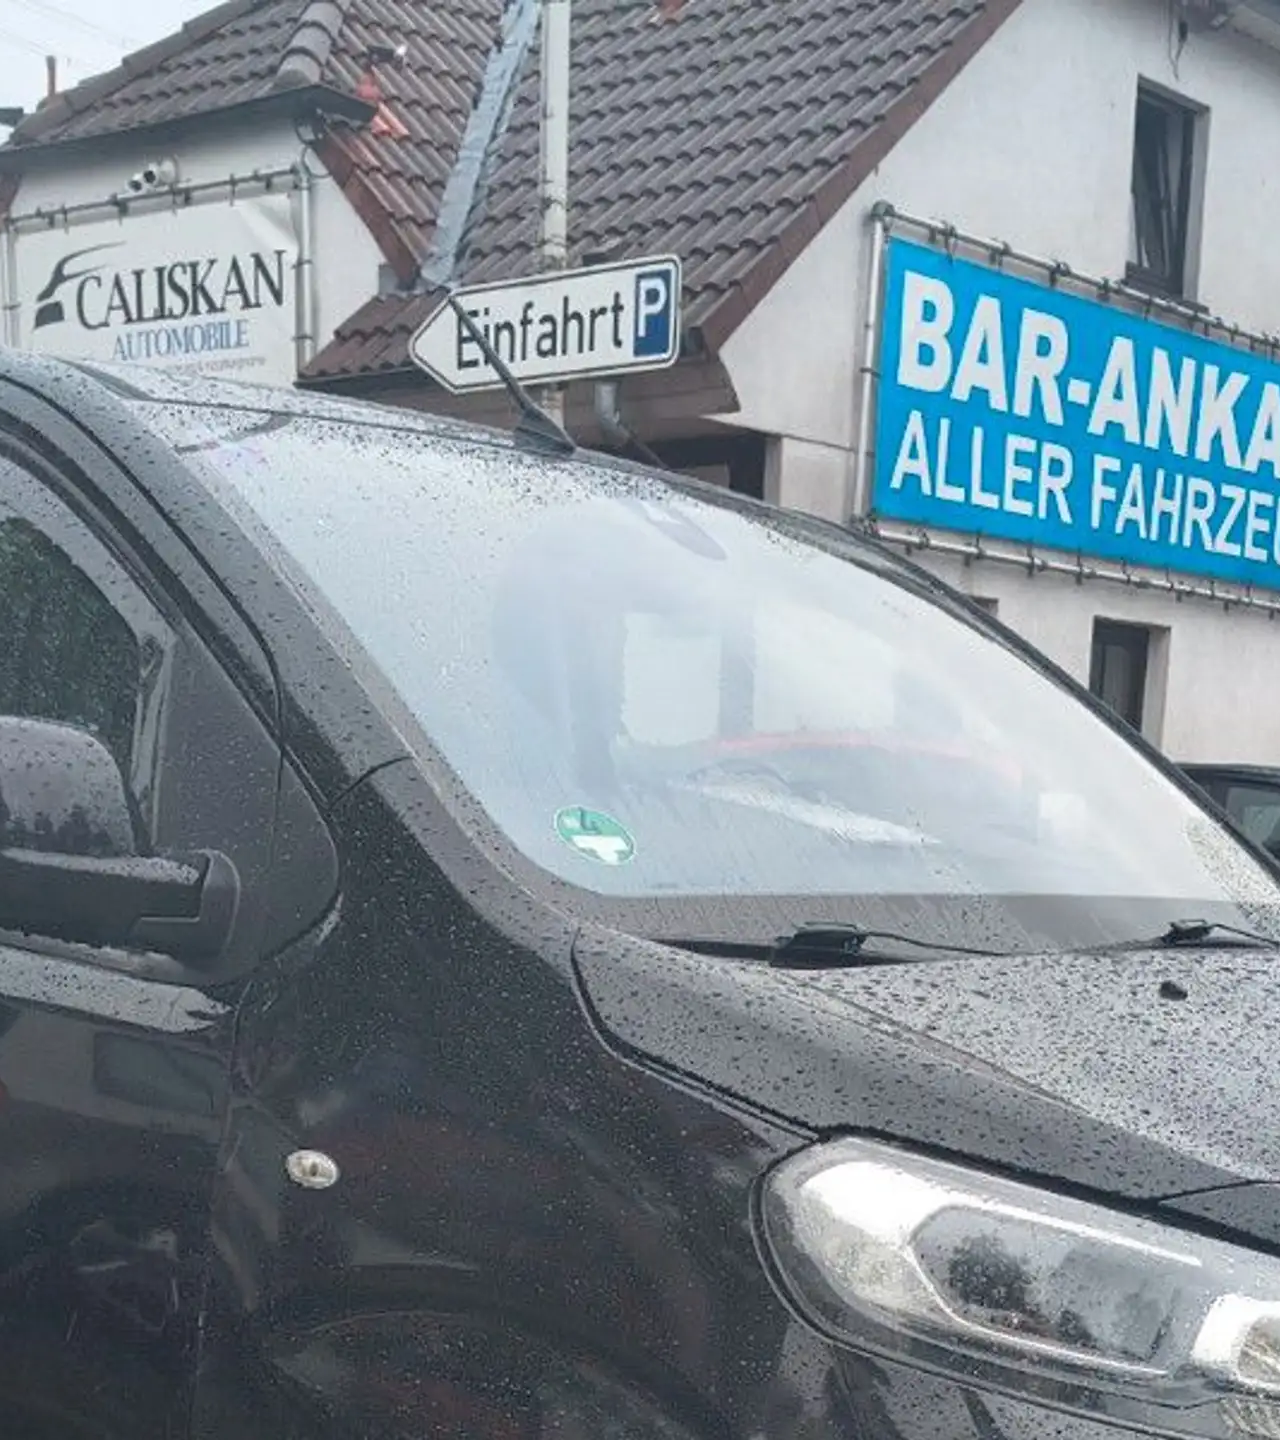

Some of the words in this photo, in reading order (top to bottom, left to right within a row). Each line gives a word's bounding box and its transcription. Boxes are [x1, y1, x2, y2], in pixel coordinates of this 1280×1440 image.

[76, 250, 287, 330] CALISKAN
[457, 292, 624, 370] Einfahrt
[638, 277, 667, 337] P
[113, 319, 249, 361] AUTOMOBILE
[890, 409, 1074, 525] ALLER
